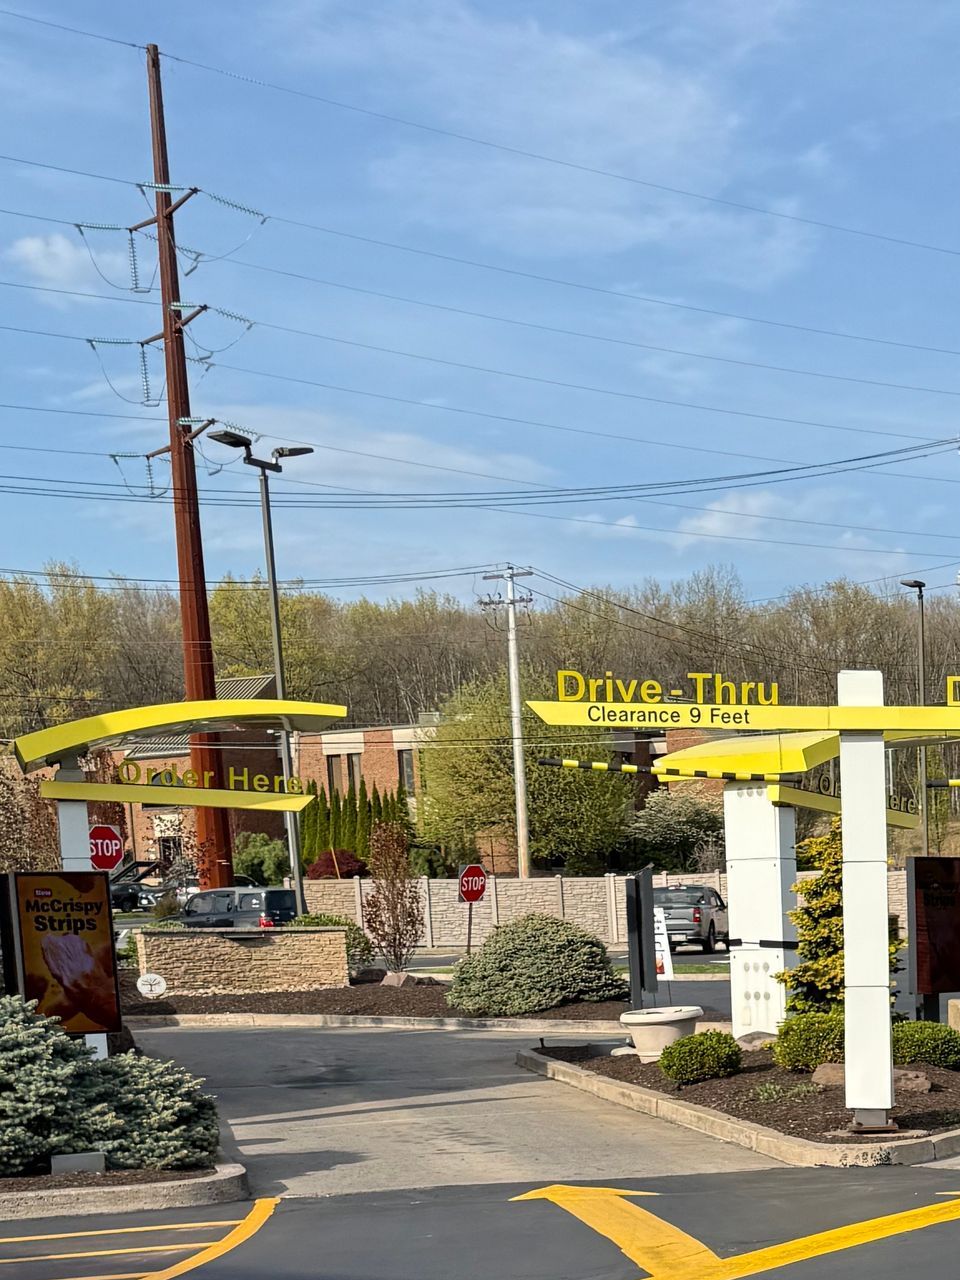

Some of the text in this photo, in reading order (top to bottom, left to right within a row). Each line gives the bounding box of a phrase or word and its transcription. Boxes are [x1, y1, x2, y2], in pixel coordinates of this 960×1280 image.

[587, 705, 750, 724] Clearance 9 Feet
[118, 760, 303, 793] Order Here
[461, 876, 485, 891] STOP
[25, 898, 104, 916] McCrispy
[34, 913, 98, 936] Strips
